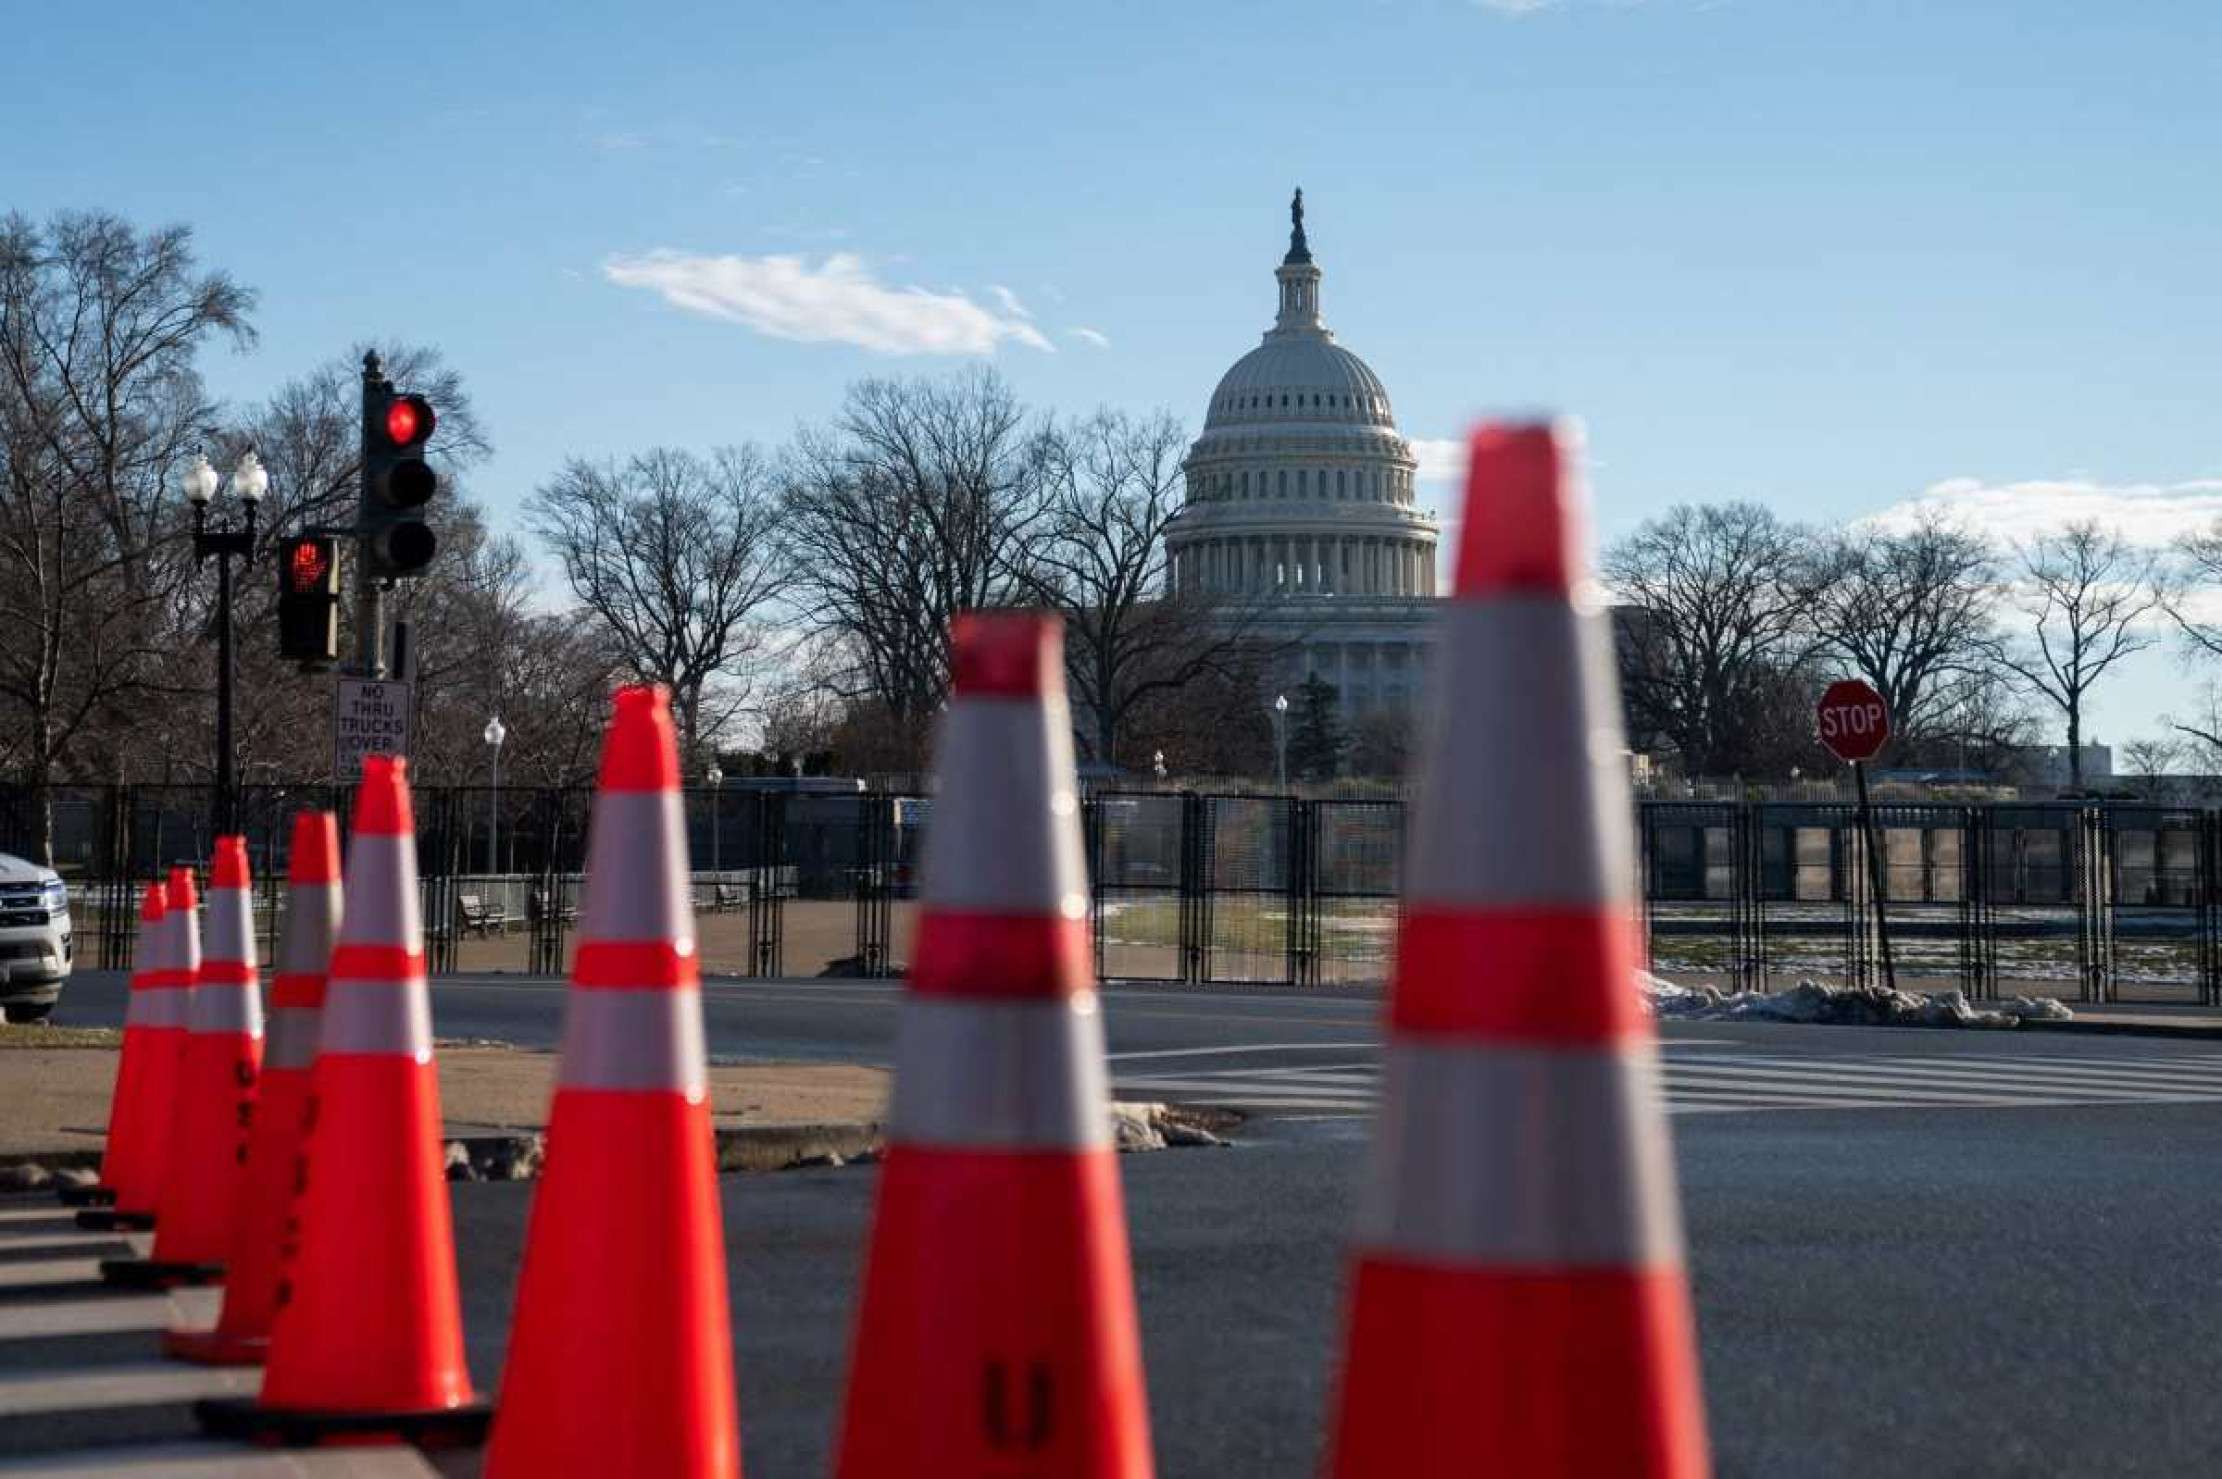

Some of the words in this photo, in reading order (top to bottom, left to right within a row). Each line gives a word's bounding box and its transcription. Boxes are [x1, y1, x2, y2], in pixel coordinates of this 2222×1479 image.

[361, 685, 384, 698] NO
[352, 700, 394, 717] THRU
[341, 717, 403, 734] TRUCKS
[1822, 704, 1882, 738] STOP
[351, 735, 393, 751] OVER
